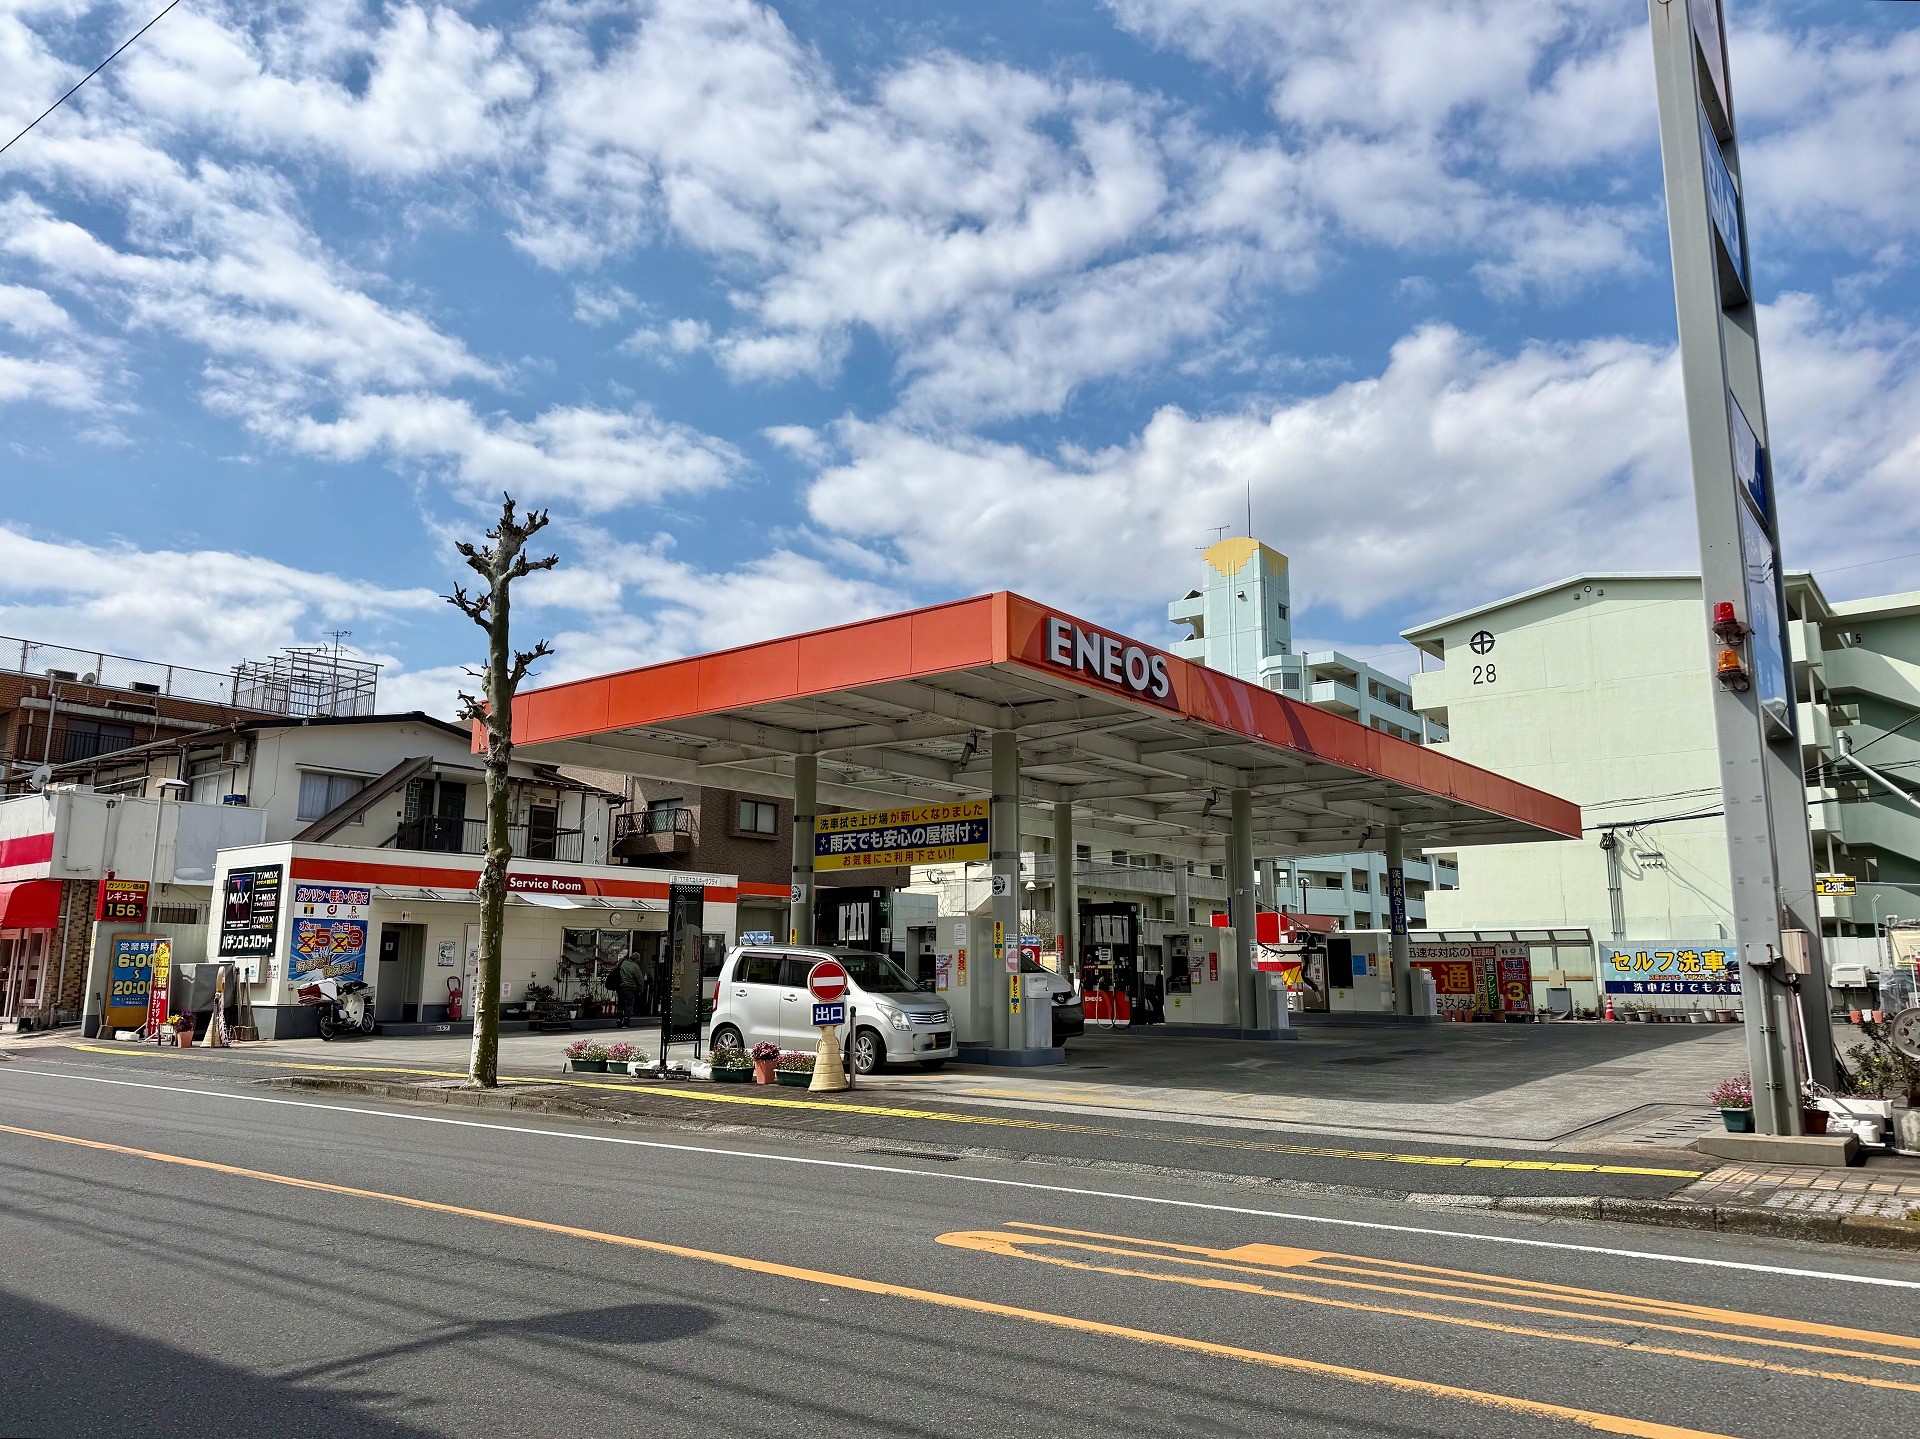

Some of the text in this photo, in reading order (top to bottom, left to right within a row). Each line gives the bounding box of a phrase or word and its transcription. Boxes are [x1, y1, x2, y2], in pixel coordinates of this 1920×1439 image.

[1855, 633, 1862, 644] 5
[1047, 617, 1169, 698] ENEOS
[1472, 664, 1496, 685] 28
[820, 804, 983, 830] 洗車拭き上げ場が新しくなりました
[830, 823, 971, 853] 雨天でも安心の屋根付
[107, 882, 146, 890] ガソリン価格
[509, 877, 581, 891] Service Room
[106, 891, 144, 901] レギュラー
[107, 903, 136, 917] 156
[315, 928, 331, 947] 5
[347, 929, 363, 948] 3
[1504, 959, 1524, 969] 毎週
[1610, 950, 1726, 973] セルフ洗車
[1506, 982, 1524, 1001] 3
[815, 1006, 843, 1021] 出口
